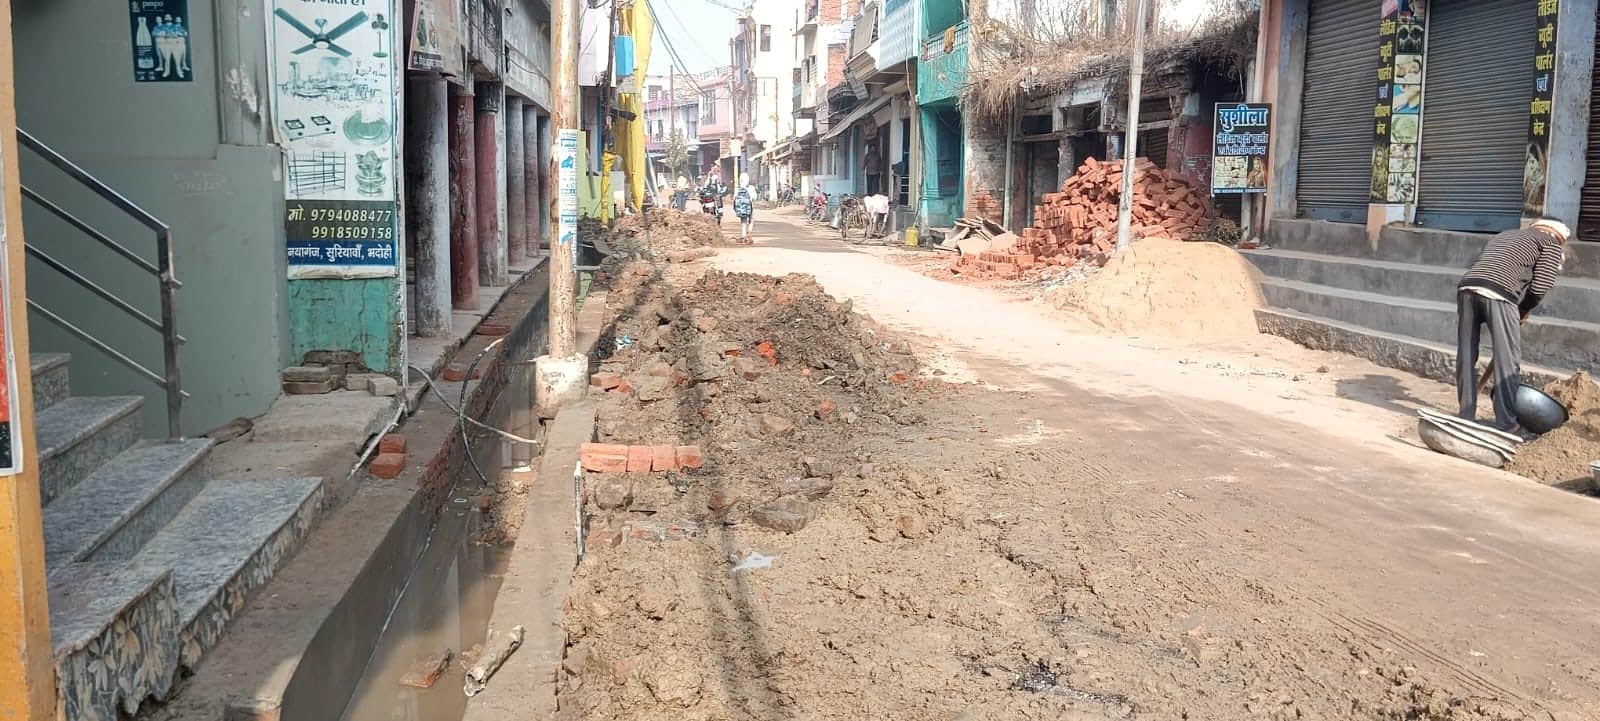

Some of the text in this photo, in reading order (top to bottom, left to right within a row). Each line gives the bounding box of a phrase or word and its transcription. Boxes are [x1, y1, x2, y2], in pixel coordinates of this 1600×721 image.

[1219, 104, 1268, 131] सुशीला
[288, 205, 392, 222] मो. 9794088477
[311, 226, 392, 239] 9918509158
[287, 244, 324, 260] नयागंज,
[367, 244, 393, 260] भदोही
